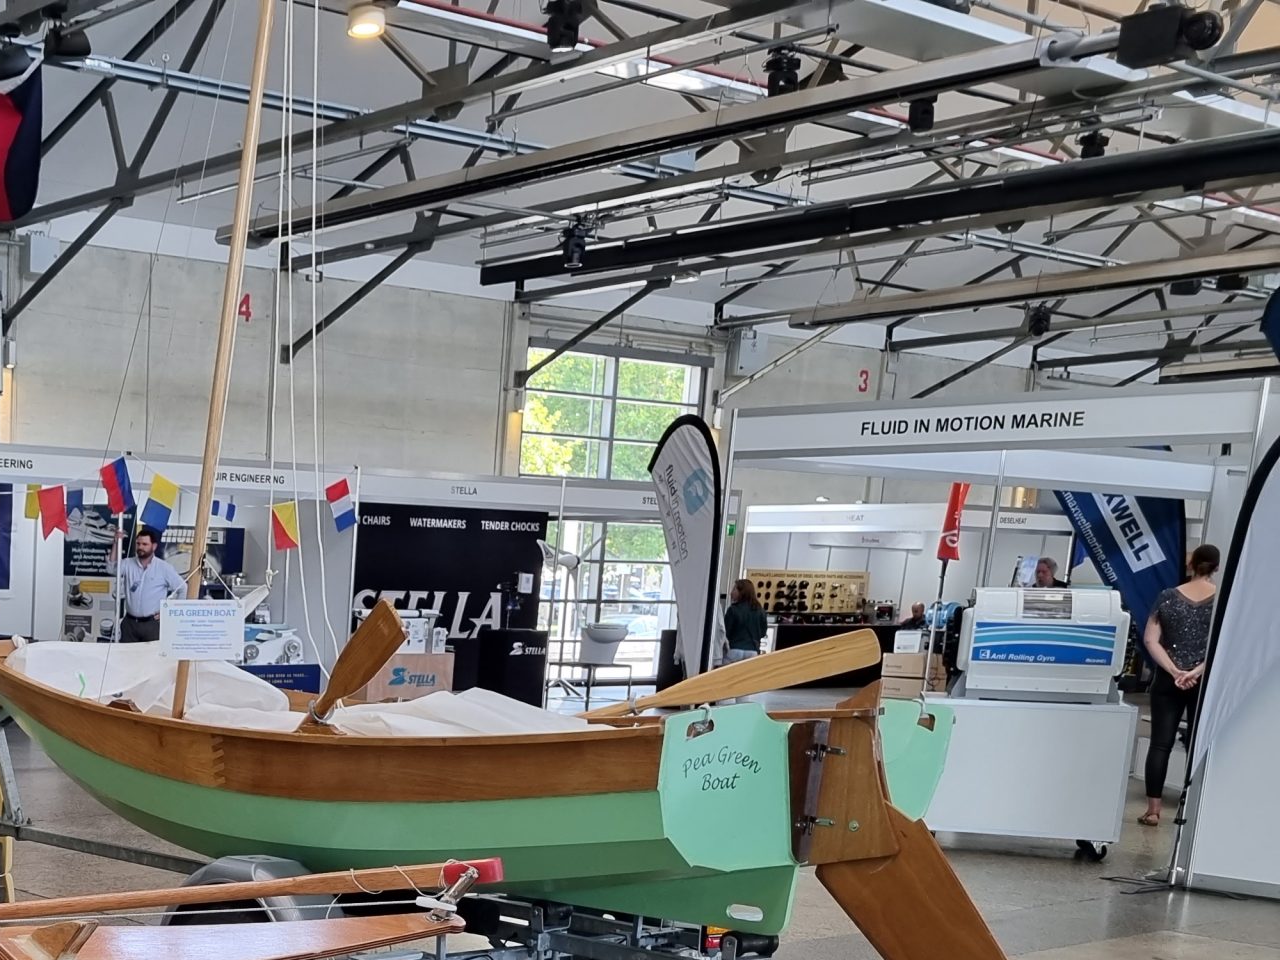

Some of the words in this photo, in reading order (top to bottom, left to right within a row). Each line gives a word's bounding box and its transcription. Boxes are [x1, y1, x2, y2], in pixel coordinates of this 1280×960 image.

[238, 293, 251, 322] 4
[858, 369, 869, 392] 3
[861, 420, 908, 436] FLUID
[913, 419, 930, 433] IN
[936, 415, 1006, 432] MOTION
[1011, 411, 1086, 429] MARINE
[450, 485, 478, 496] STELLA
[642, 497, 658, 505] STEL
[665, 464, 677, 496] fluid
[673, 511, 689, 561] motion
[362, 516, 391, 526] CHAIRS
[410, 517, 467, 529] WATERMAKERS
[481, 520, 509, 531] TENDER
[510, 521, 540, 532] CHOCKS
[169, 609, 184, 617] PEA
[185, 609, 213, 617] GREEN
[214, 609, 237, 617] BOAT
[524, 646, 546, 655] STELLA
[991, 652, 1006, 660] Anti
[1008, 653, 1035, 662] Rolling
[1037, 654, 1055, 662] Gyro
[408, 674, 436, 687] STELLA
[682, 752, 715, 778] Pea
[718, 745, 761, 773] Green
[702, 772, 741, 791] Boat
